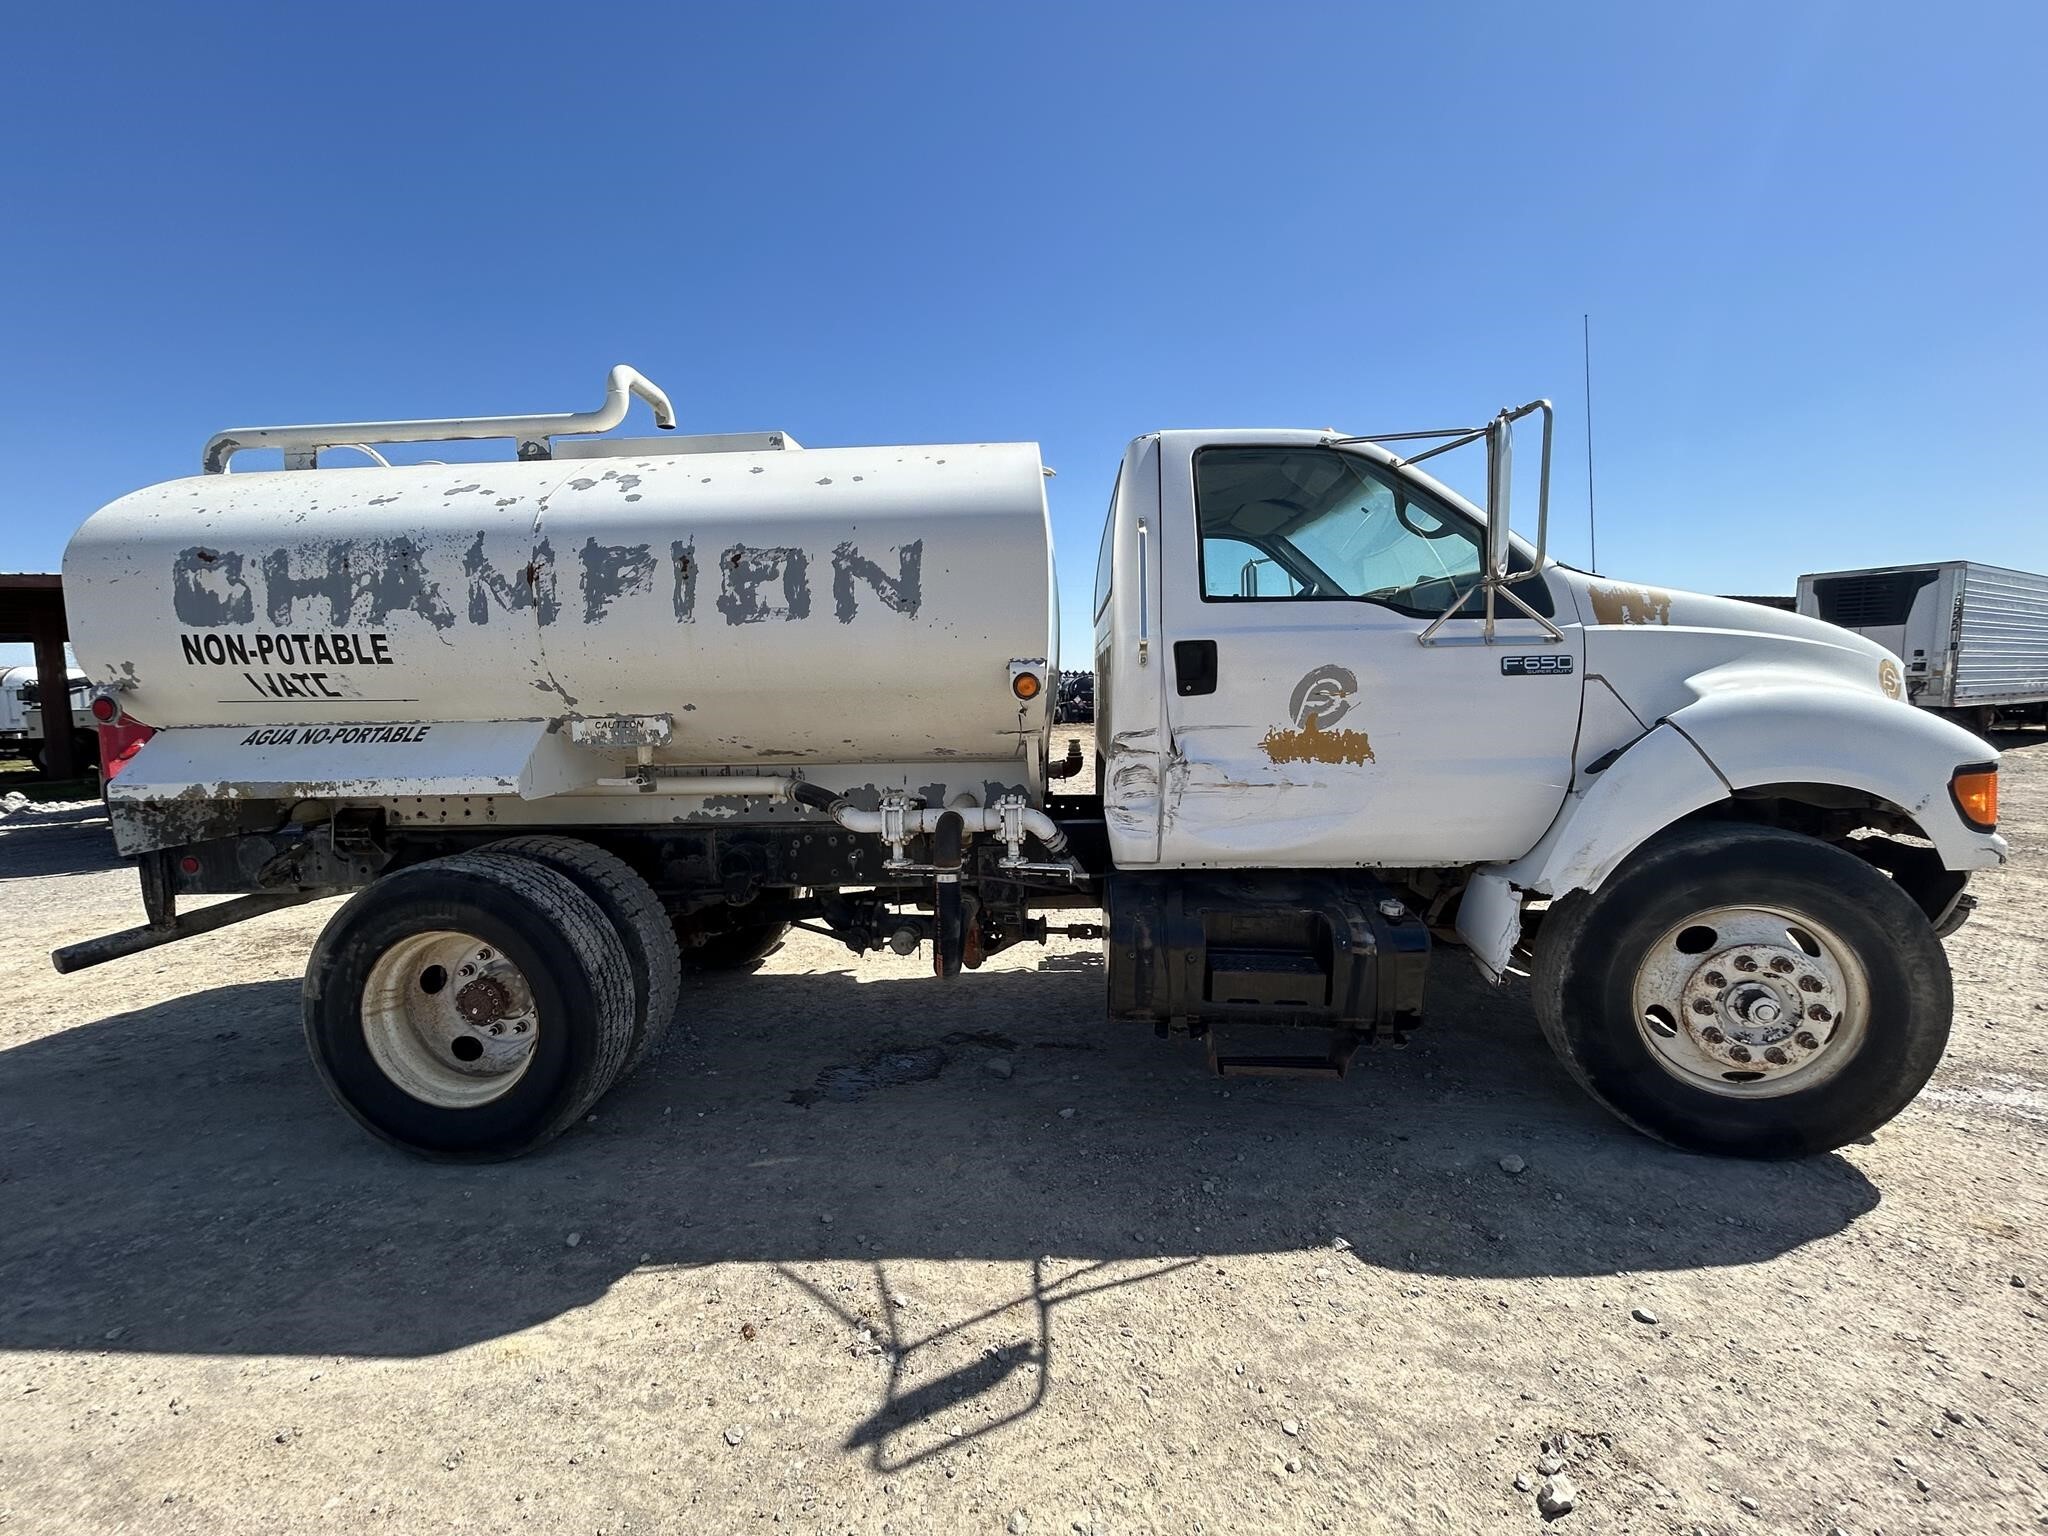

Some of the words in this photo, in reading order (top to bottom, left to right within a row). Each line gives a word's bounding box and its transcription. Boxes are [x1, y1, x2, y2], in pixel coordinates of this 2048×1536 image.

[180, 634, 394, 665] NON-POTABLE
[243, 673, 358, 697] WATE
[594, 720, 645, 729] CAUTION
[240, 728, 298, 746] AGUA
[297, 726, 431, 745] NO-PORTABLE
